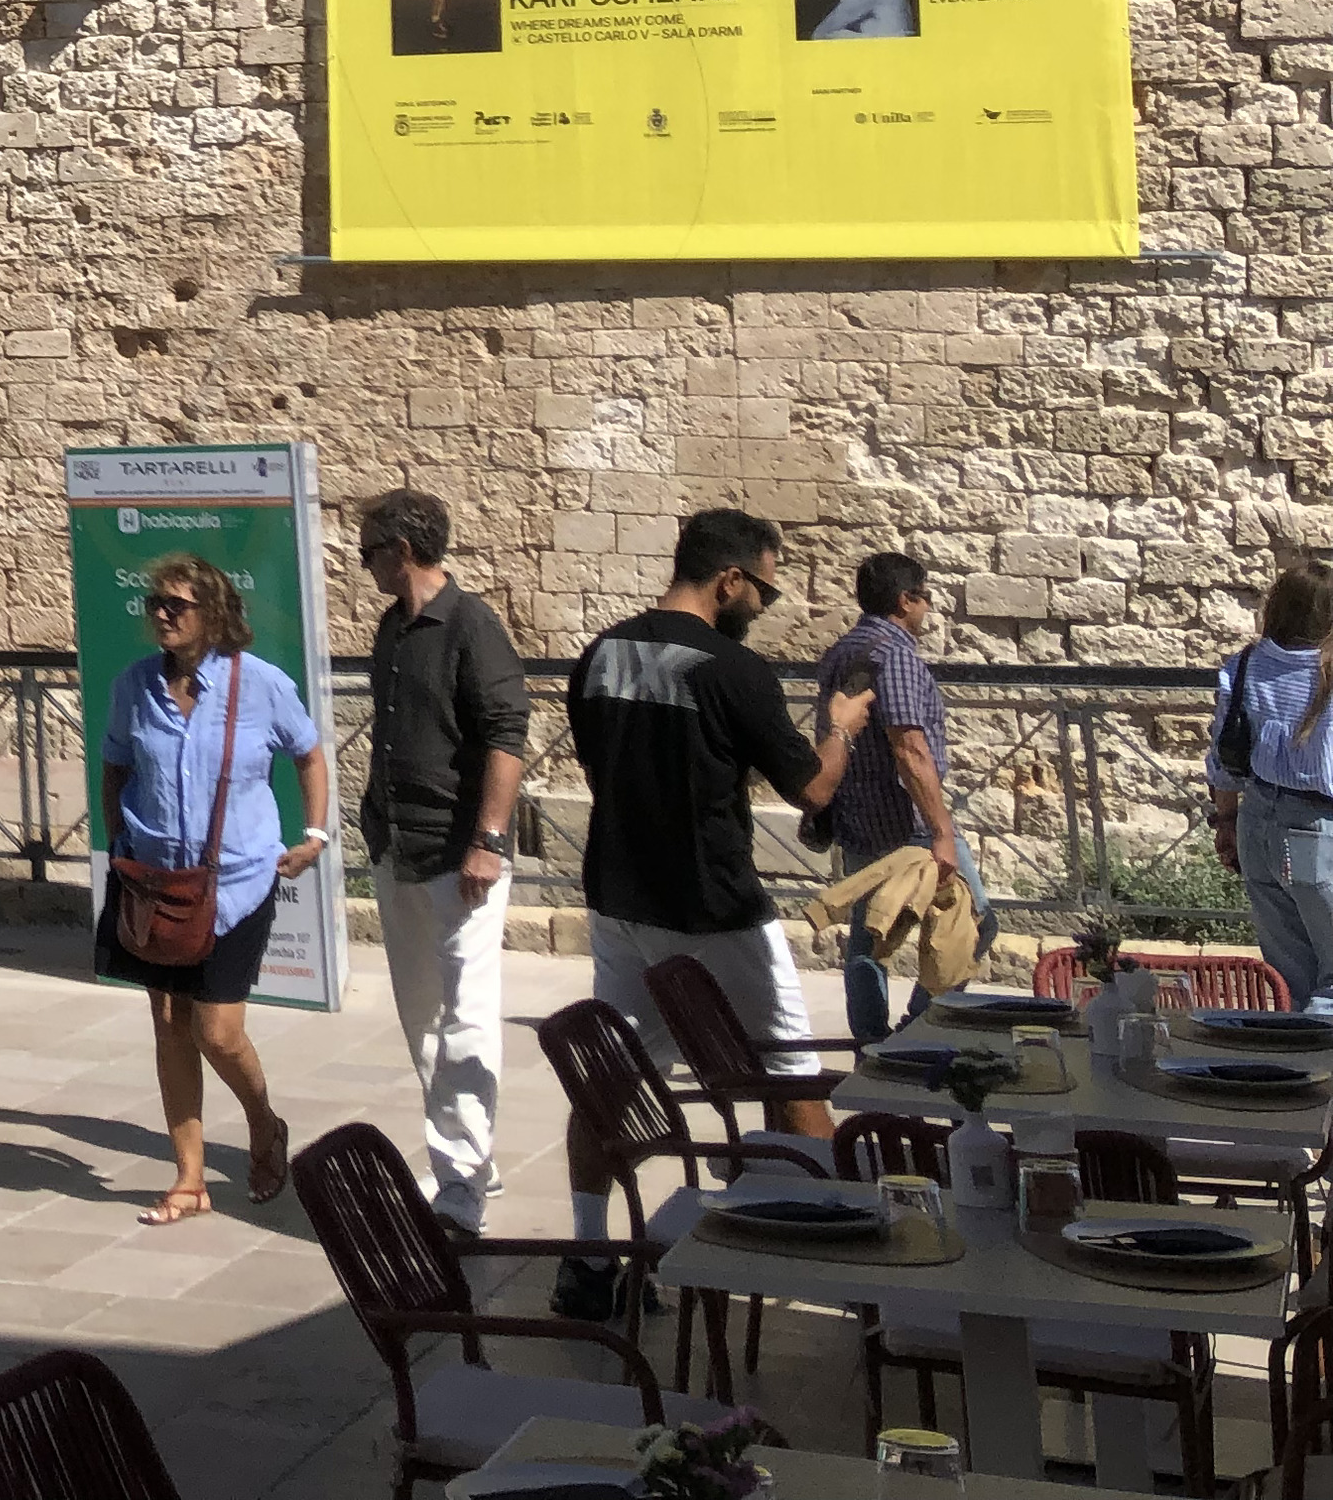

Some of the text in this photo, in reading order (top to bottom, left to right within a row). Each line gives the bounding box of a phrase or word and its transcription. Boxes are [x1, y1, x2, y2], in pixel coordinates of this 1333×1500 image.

[510, 13, 684, 31] WHERE DREAMS MAY COME
[527, 30, 592, 44] CASTELLO
[594, 29, 638, 42] CARLO
[640, 29, 650, 40] V
[661, 26, 695, 39] SALA
[698, 25, 743, 38] D'ARMI
[118, 460, 237, 477] TARTARELLI
